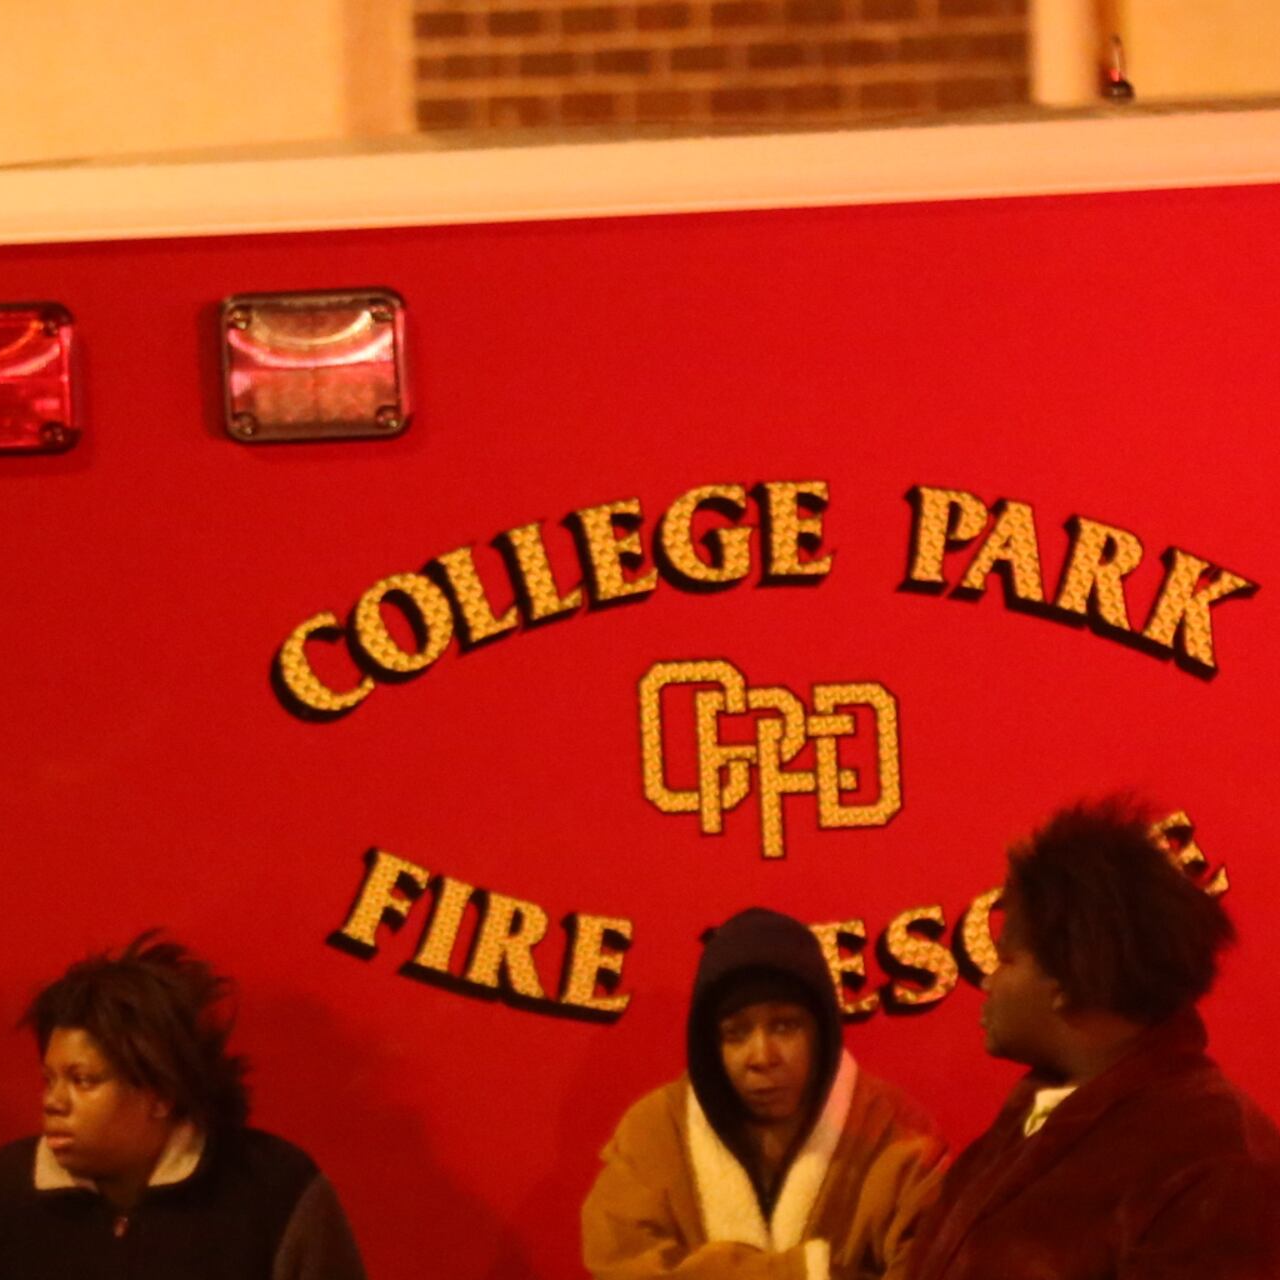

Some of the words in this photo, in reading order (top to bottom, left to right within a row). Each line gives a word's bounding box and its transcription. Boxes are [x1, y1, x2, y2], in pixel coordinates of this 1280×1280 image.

[270, 480, 833, 722] COLLEGE
[900, 484, 1260, 680] PARK
[326, 845, 635, 1026] FIRE
